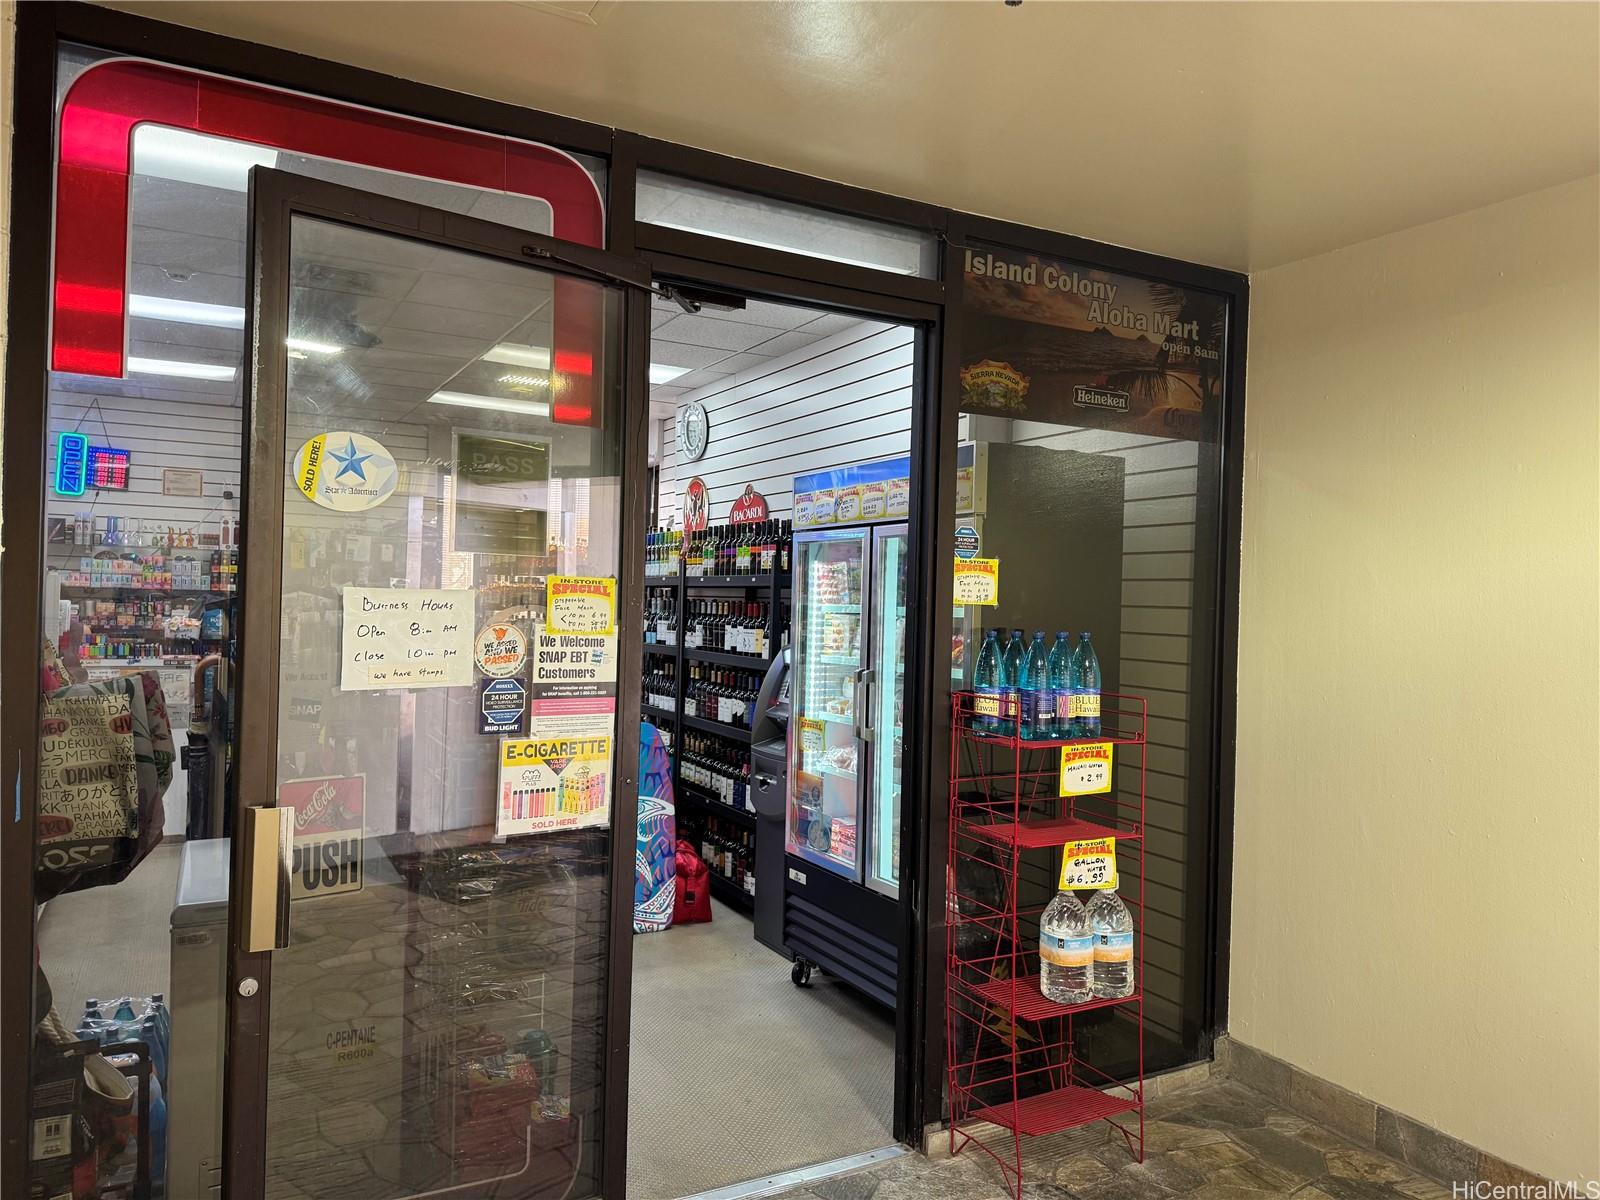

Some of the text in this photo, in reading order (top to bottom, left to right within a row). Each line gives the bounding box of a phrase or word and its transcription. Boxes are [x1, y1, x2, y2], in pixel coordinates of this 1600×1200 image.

[964, 250, 1118, 304] Island Colony
[1088, 300, 1199, 340] Aloha Mart
[1162, 341, 1219, 360] open 8am
[969, 370, 995, 380] SIERRA
[1077, 389, 1126, 408] Heineken
[64, 437, 82, 492] OPEN
[304, 440, 322, 492] SOLD HERE!
[734, 505, 763, 522] BACARDI
[552, 583, 611, 597] SPECIAL
[421, 599, 454, 611] Hours
[357, 624, 386, 638] Open
[539, 635, 605, 647] We Welcome
[504, 645, 519, 655] WE
[484, 653, 519, 666] PASSED
[539, 651, 588, 663] SNAP EBT
[538, 667, 596, 679] Customers
[500, 693, 518, 701] HOUR
[1075, 695, 1100, 705] BLUE
[288, 704, 322, 715] SNAP
[71, 718, 107, 727] DANKE
[500, 724, 519, 732] LIGHT
[70, 727, 109, 737] GRAZIE
[65, 749, 111, 762] MERCI
[506, 740, 607, 759] E-CIGARETTE
[1065, 750, 1109, 763] SPECIAL
[65, 764, 120, 786] DANKE
[64, 799, 109, 813] THANK
[74, 808, 129, 821] RAHMAT
[532, 818, 578, 829] SOLD HERE
[74, 828, 129, 839] SALAMAT
[1074, 840, 1106, 848] IN-STORE
[1068, 845, 1112, 858] SPECIAL
[1074, 858, 1105, 867] GALLON
[326, 1026, 375, 1049] C-PENTANE
